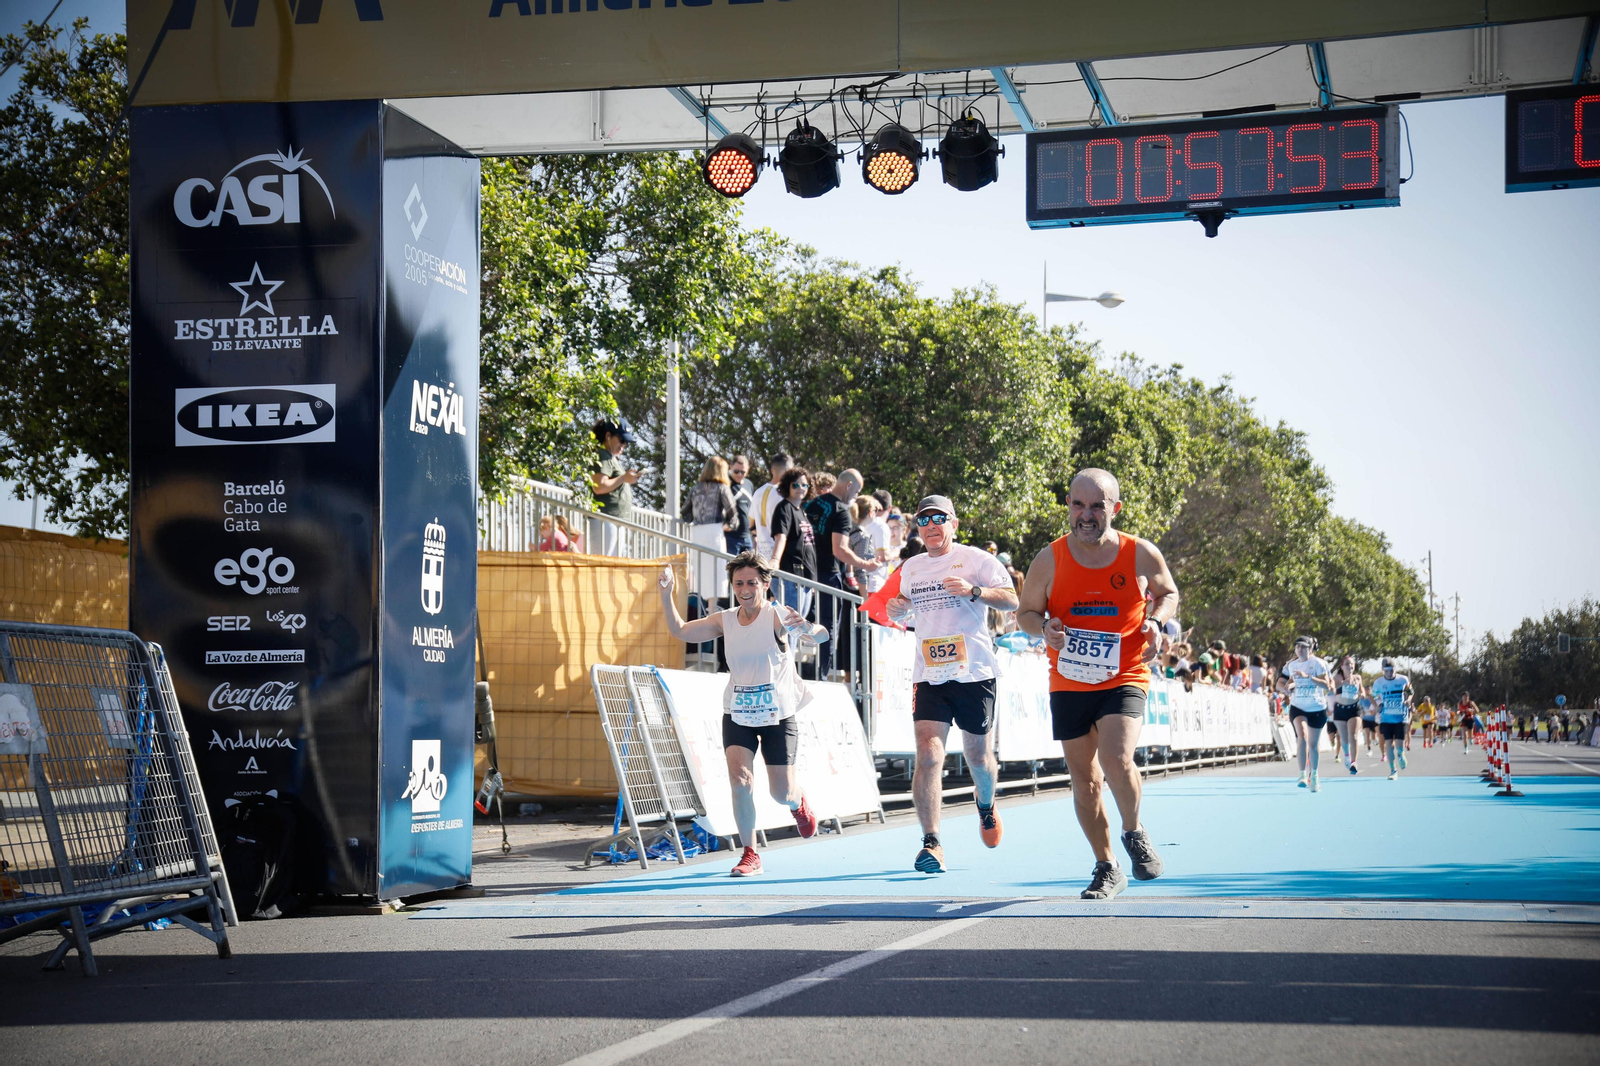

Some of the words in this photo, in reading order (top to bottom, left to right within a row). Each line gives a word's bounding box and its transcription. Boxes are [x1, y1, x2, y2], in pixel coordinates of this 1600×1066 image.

[173, 173, 301, 228] CASI
[404, 243, 467, 285] COOPERACIÓN
[404, 262, 428, 286] 2005
[174, 314, 338, 340] ESTRELLA
[211, 340, 232, 351] DE
[234, 338, 302, 351] LEVANTE
[198, 402, 318, 429] IKEA
[223, 480, 286, 496] Barceló
[223, 499, 264, 515] Cabo
[267, 498, 287, 514] de
[223, 517, 261, 532] Gata
[214, 547, 296, 595] ego
[266, 586, 281, 596] sport
[281, 585, 300, 594] center
[910, 584, 937, 596] Almería
[206, 615, 251, 632] SER
[412, 624, 455, 649] ALMERÍA
[423, 649, 446, 663] CIUDAD
[929, 643, 957, 659] 852
[1066, 637, 1114, 659] 5857
[207, 653, 221, 663] La
[221, 653, 243, 663] Voz
[243, 653, 258, 662] de
[258, 652, 303, 662] Almería
[735, 691, 773, 706] 5570
[208, 728, 298, 752] Andalucía
